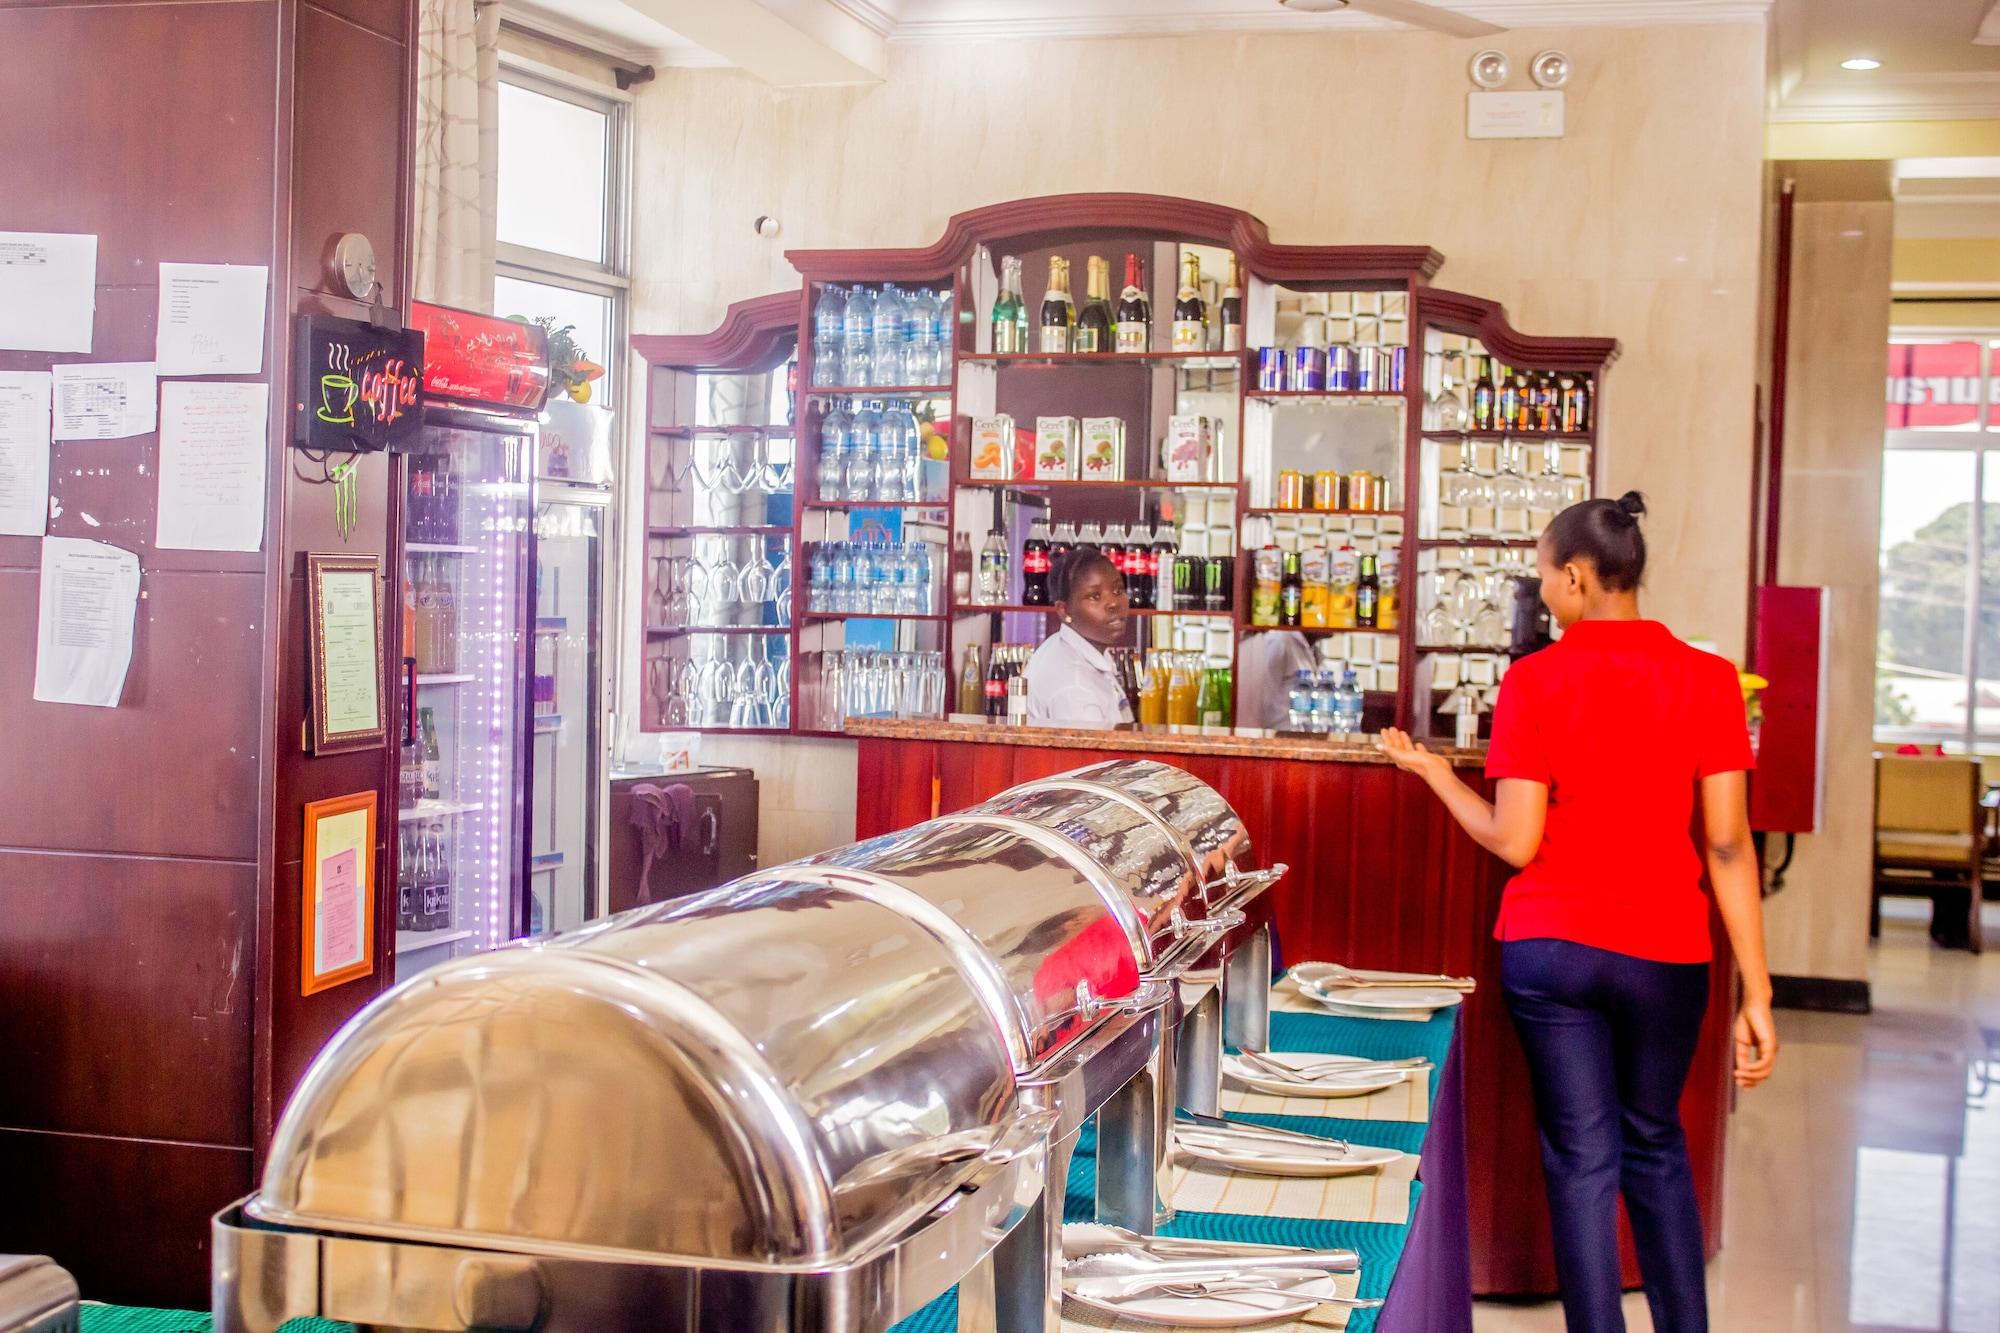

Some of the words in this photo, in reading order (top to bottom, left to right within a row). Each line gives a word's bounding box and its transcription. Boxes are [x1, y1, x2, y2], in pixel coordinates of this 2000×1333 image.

[361, 358, 418, 421] coffee
[975, 418, 1000, 429] Ceres
[1040, 420, 1065, 430] Ceres
[1086, 420, 1111, 431] Ceres
